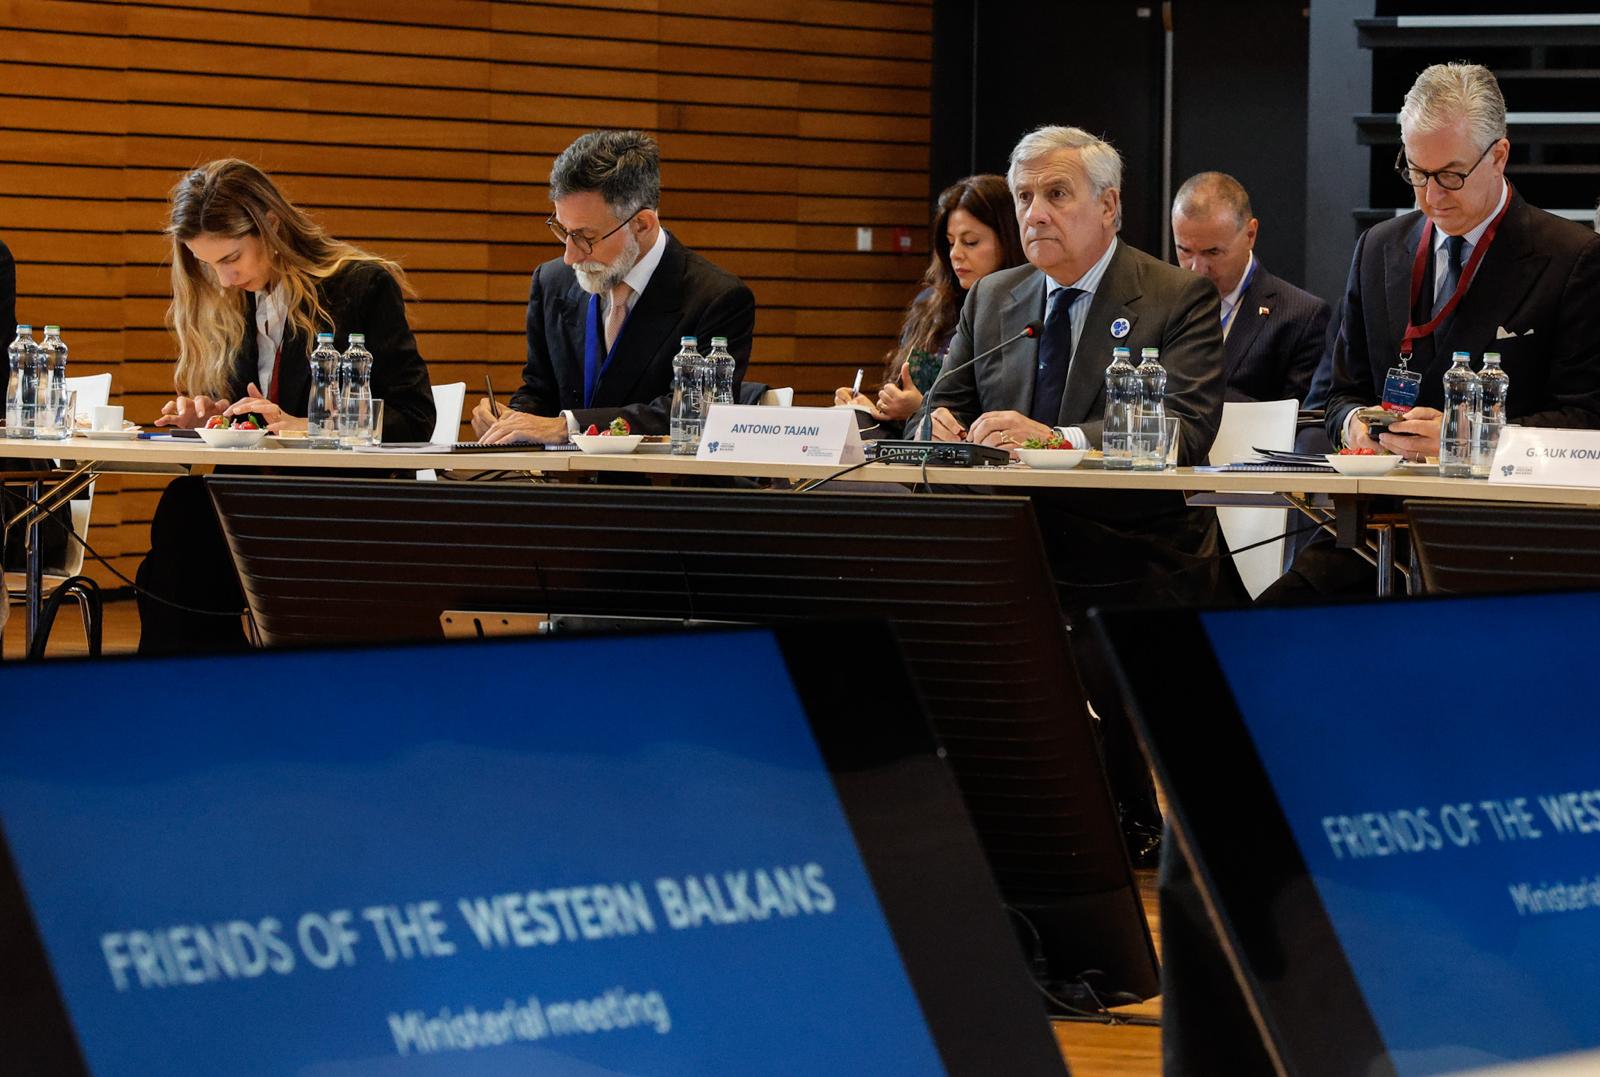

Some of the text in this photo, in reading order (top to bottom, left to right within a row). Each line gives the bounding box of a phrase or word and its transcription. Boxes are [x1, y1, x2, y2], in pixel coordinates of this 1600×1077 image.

[731, 424, 820, 436] ANTONIO TAJANI
[1321, 805, 1443, 859] FRIENDS
[1440, 802, 1480, 847] OF
[1479, 797, 1542, 841] THE
[102, 862, 836, 992] FRIENDS OF THE WESTERN BALKANS
[387, 986, 672, 1056] Ministerial meeting
